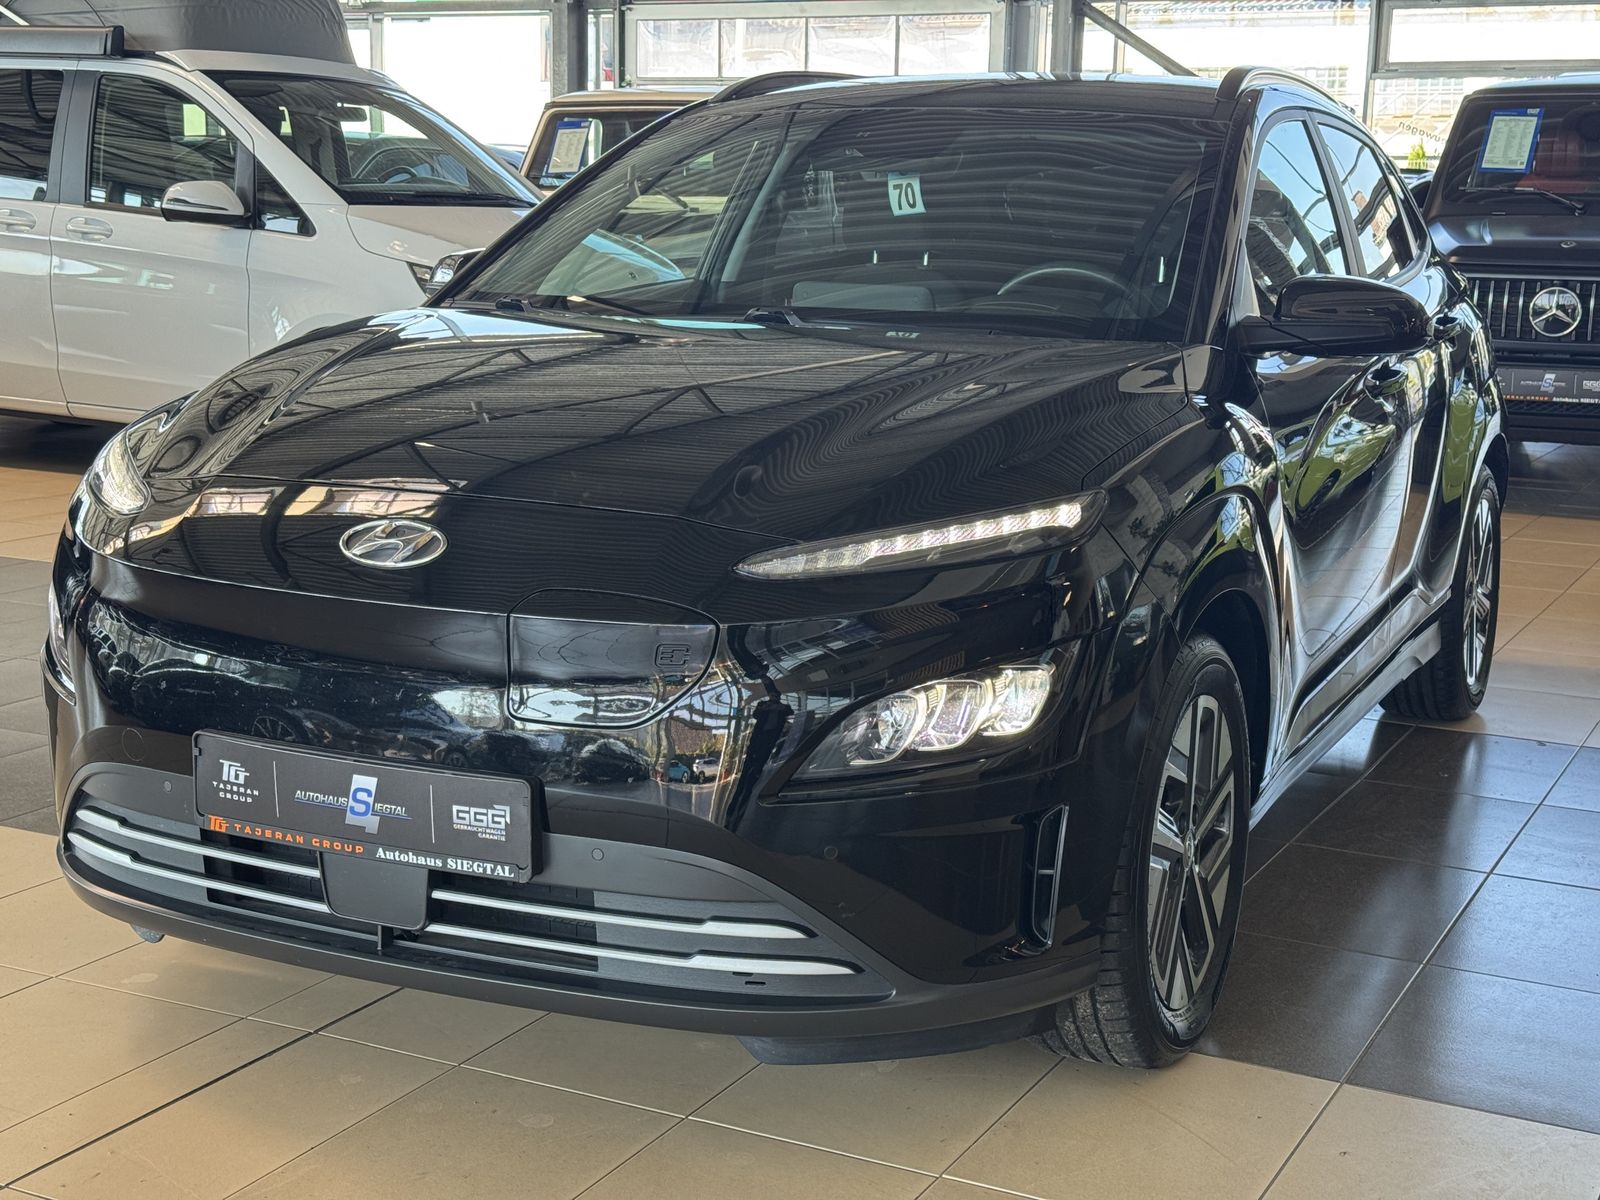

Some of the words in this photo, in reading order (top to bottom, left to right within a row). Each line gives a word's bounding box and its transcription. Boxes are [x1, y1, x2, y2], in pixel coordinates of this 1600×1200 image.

[892, 182, 917, 211] 70
[212, 781, 259, 796] TAJERAN
[219, 792, 253, 803] GROUP
[294, 790, 348, 807] AUTOHAUS
[452, 804, 508, 829] GGG
[478, 833, 506, 842] GARANTIE
[234, 824, 304, 844] TAJERAN
[312, 838, 364, 854] GROUP
[376, 847, 443, 867] Autohaus
[447, 858, 515, 877] SIEGTAL
